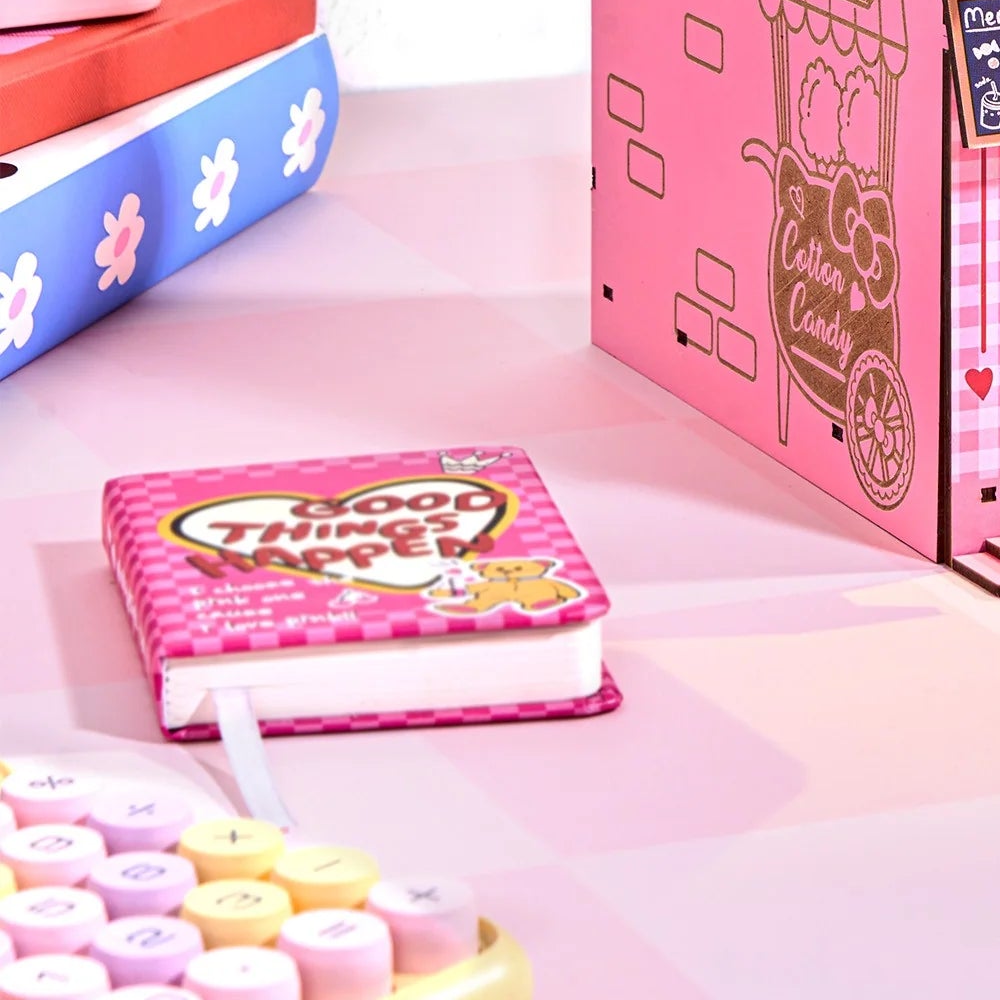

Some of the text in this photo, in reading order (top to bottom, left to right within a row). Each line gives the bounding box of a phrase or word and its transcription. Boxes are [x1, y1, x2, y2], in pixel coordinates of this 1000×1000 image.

[974, 76, 992, 89] soda
[782, 219, 845, 294] Cotton
[790, 281, 853, 370] Candy
[290, 491, 507, 518] GOOD
[207, 513, 459, 545] THINGS
[184, 534, 495, 579] HAPPEN
